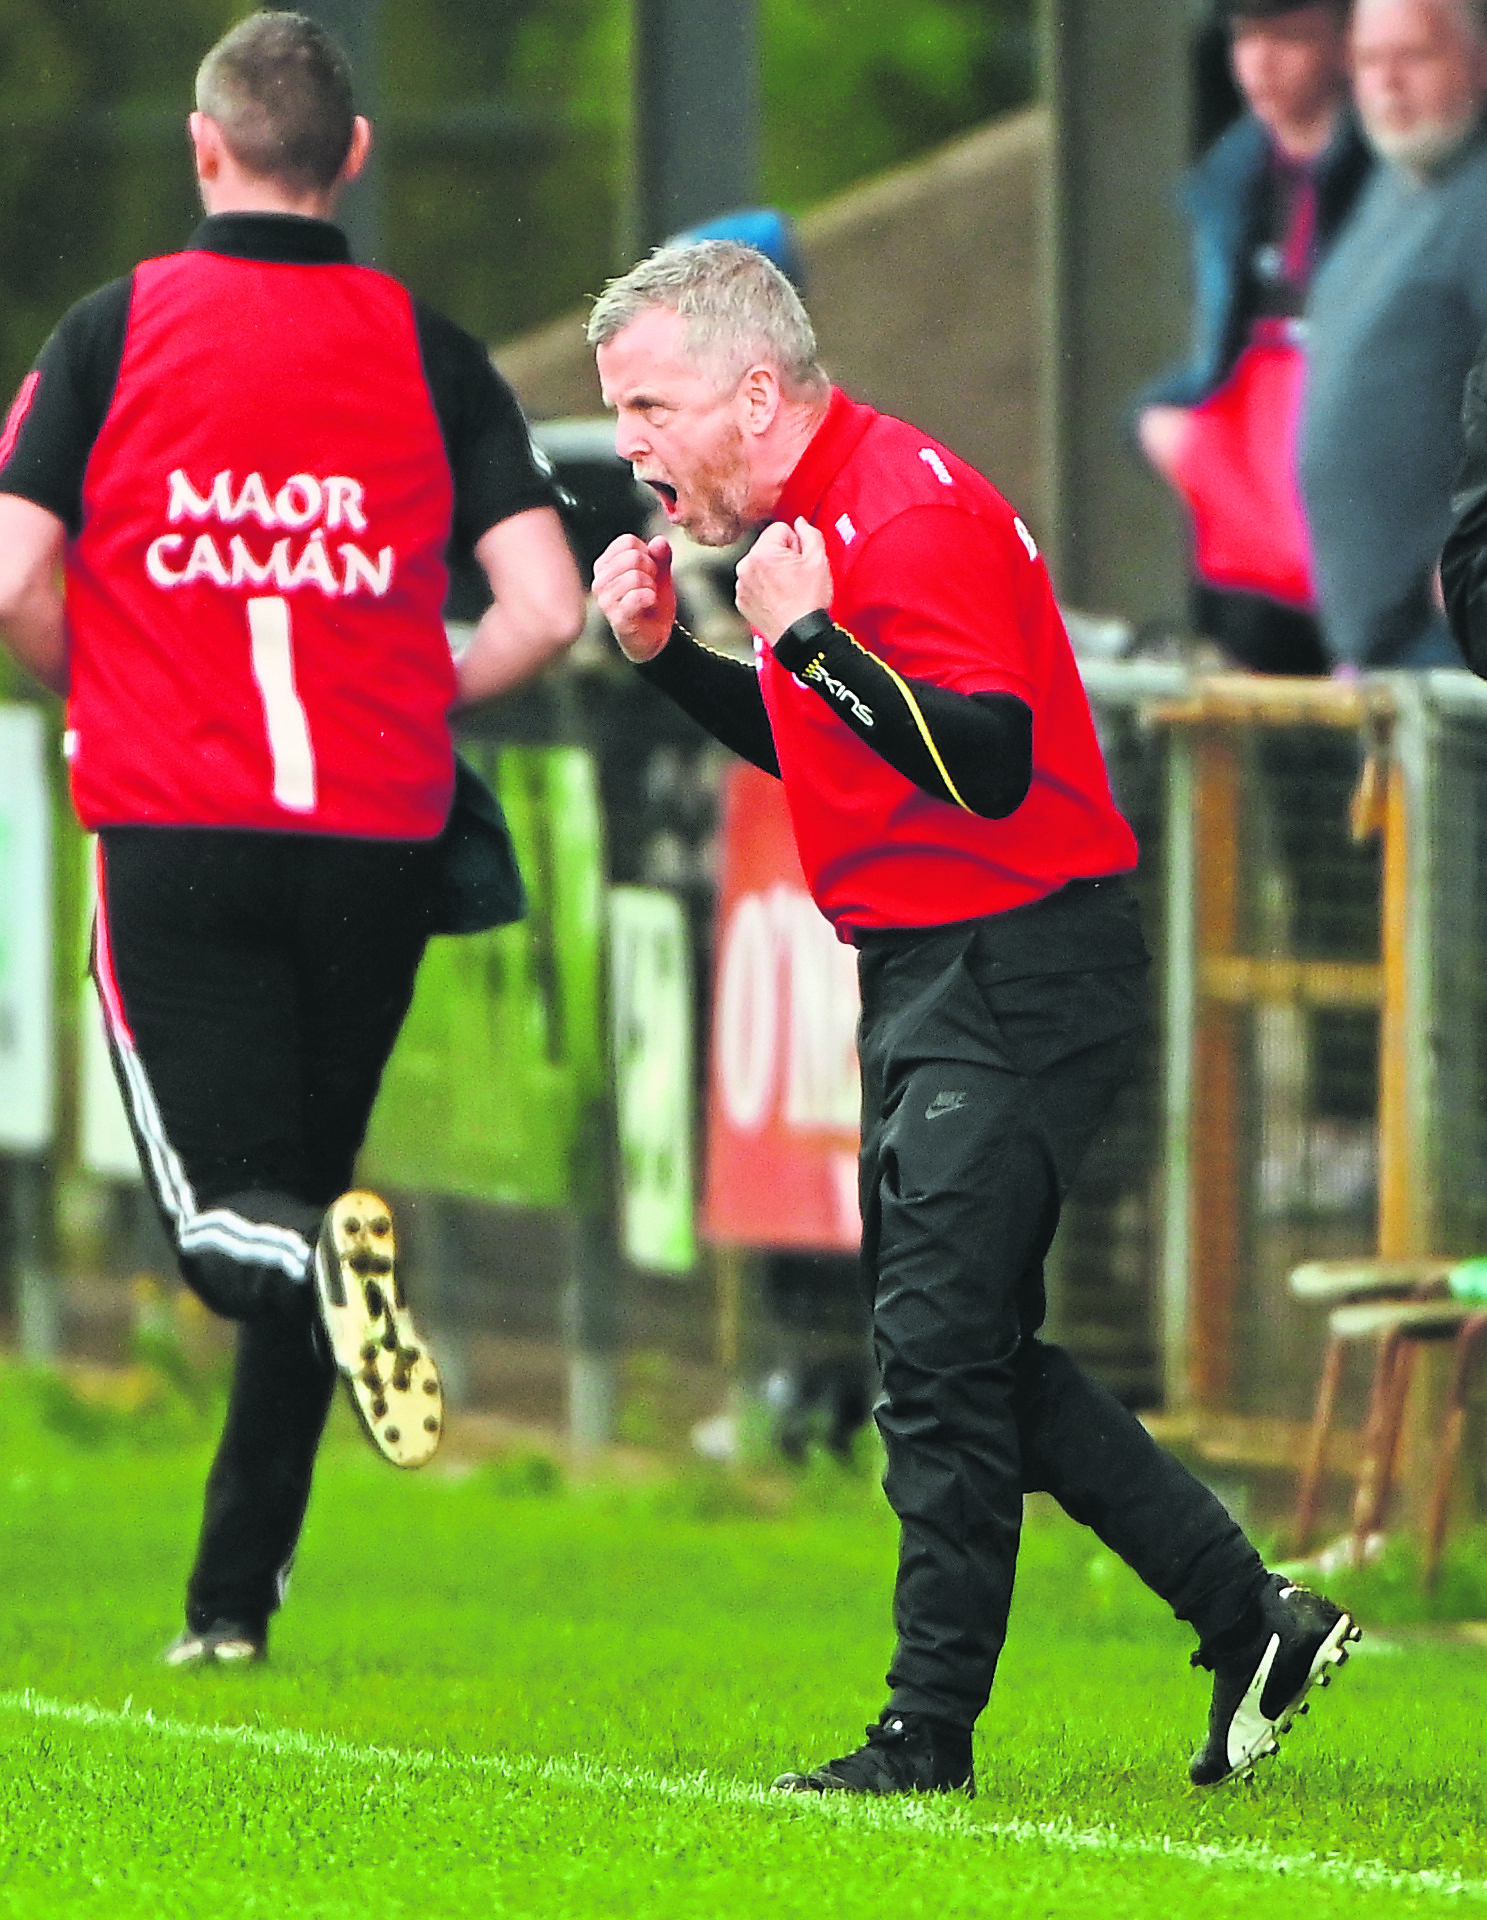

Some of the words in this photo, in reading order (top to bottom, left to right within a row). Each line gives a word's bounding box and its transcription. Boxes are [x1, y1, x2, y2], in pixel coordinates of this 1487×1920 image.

[168, 469, 367, 529] MAOR
[146, 528, 394, 597] CAMÁN
[246, 596, 317, 813] 1
